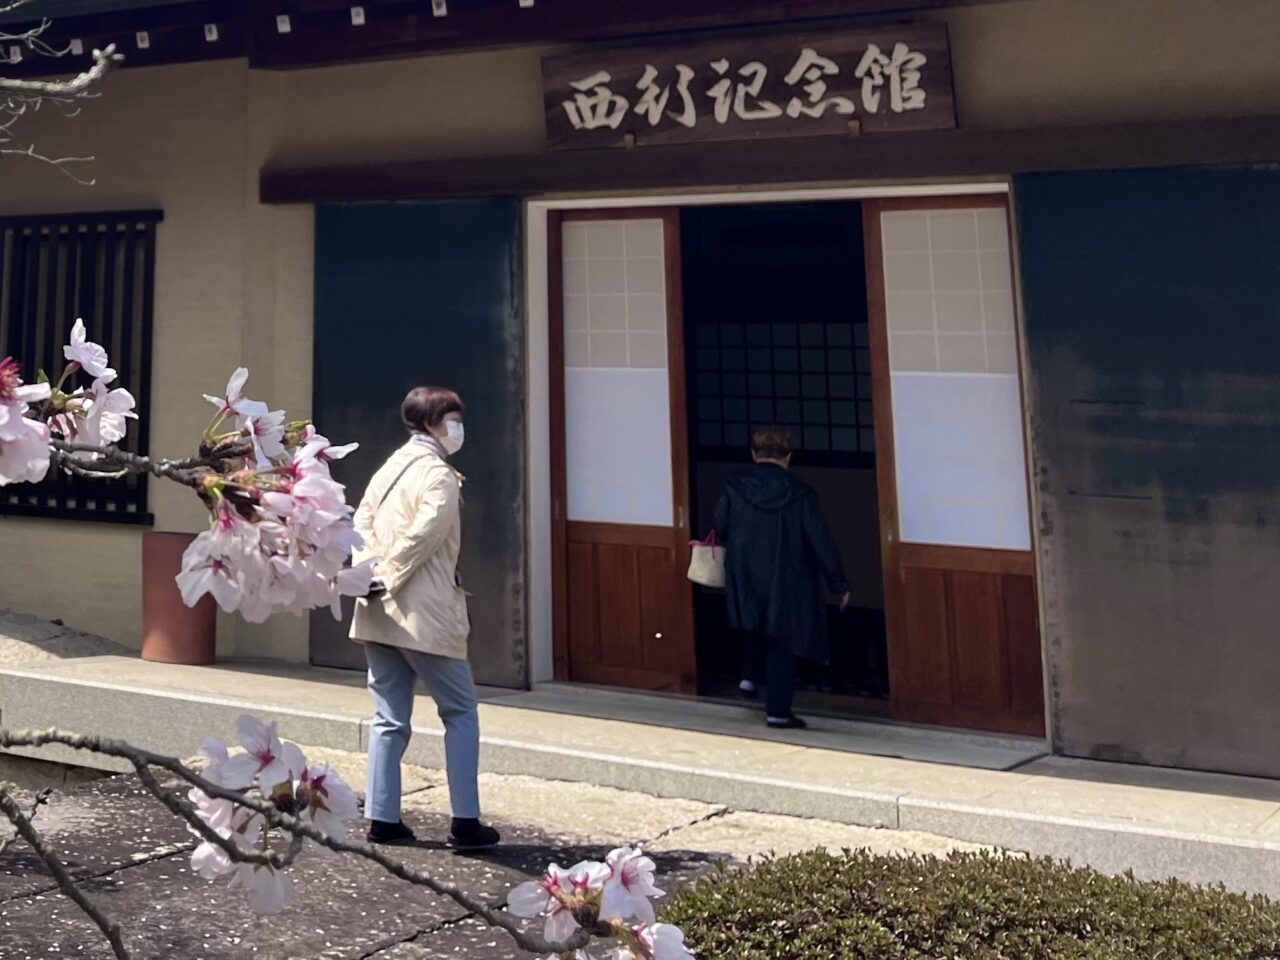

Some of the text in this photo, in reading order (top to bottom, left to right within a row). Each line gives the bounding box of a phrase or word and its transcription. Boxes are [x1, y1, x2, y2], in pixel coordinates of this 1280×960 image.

[562, 41, 927, 130] 西行記念館
